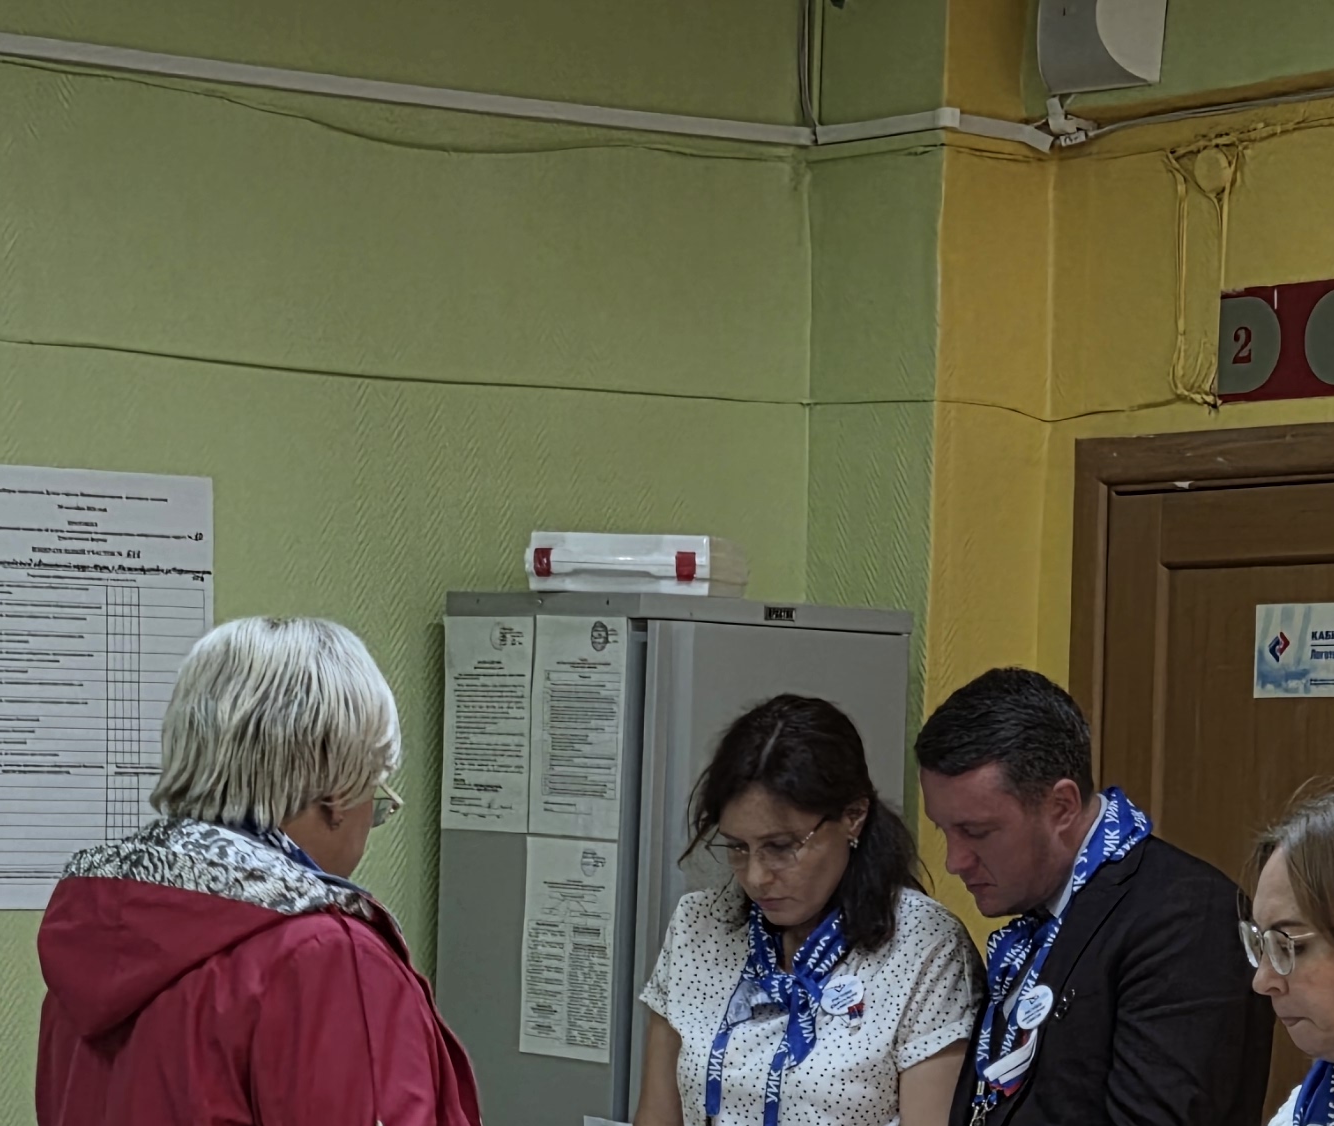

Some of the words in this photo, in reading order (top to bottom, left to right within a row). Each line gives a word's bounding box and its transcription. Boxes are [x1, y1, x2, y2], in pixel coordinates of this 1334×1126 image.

[1231, 326, 1252, 365] 2
[1102, 828, 1120, 857] ИК
[977, 1027, 991, 1062] УИК
[708, 1049, 725, 1082] УИК
[765, 1069, 782, 1103] УИК
